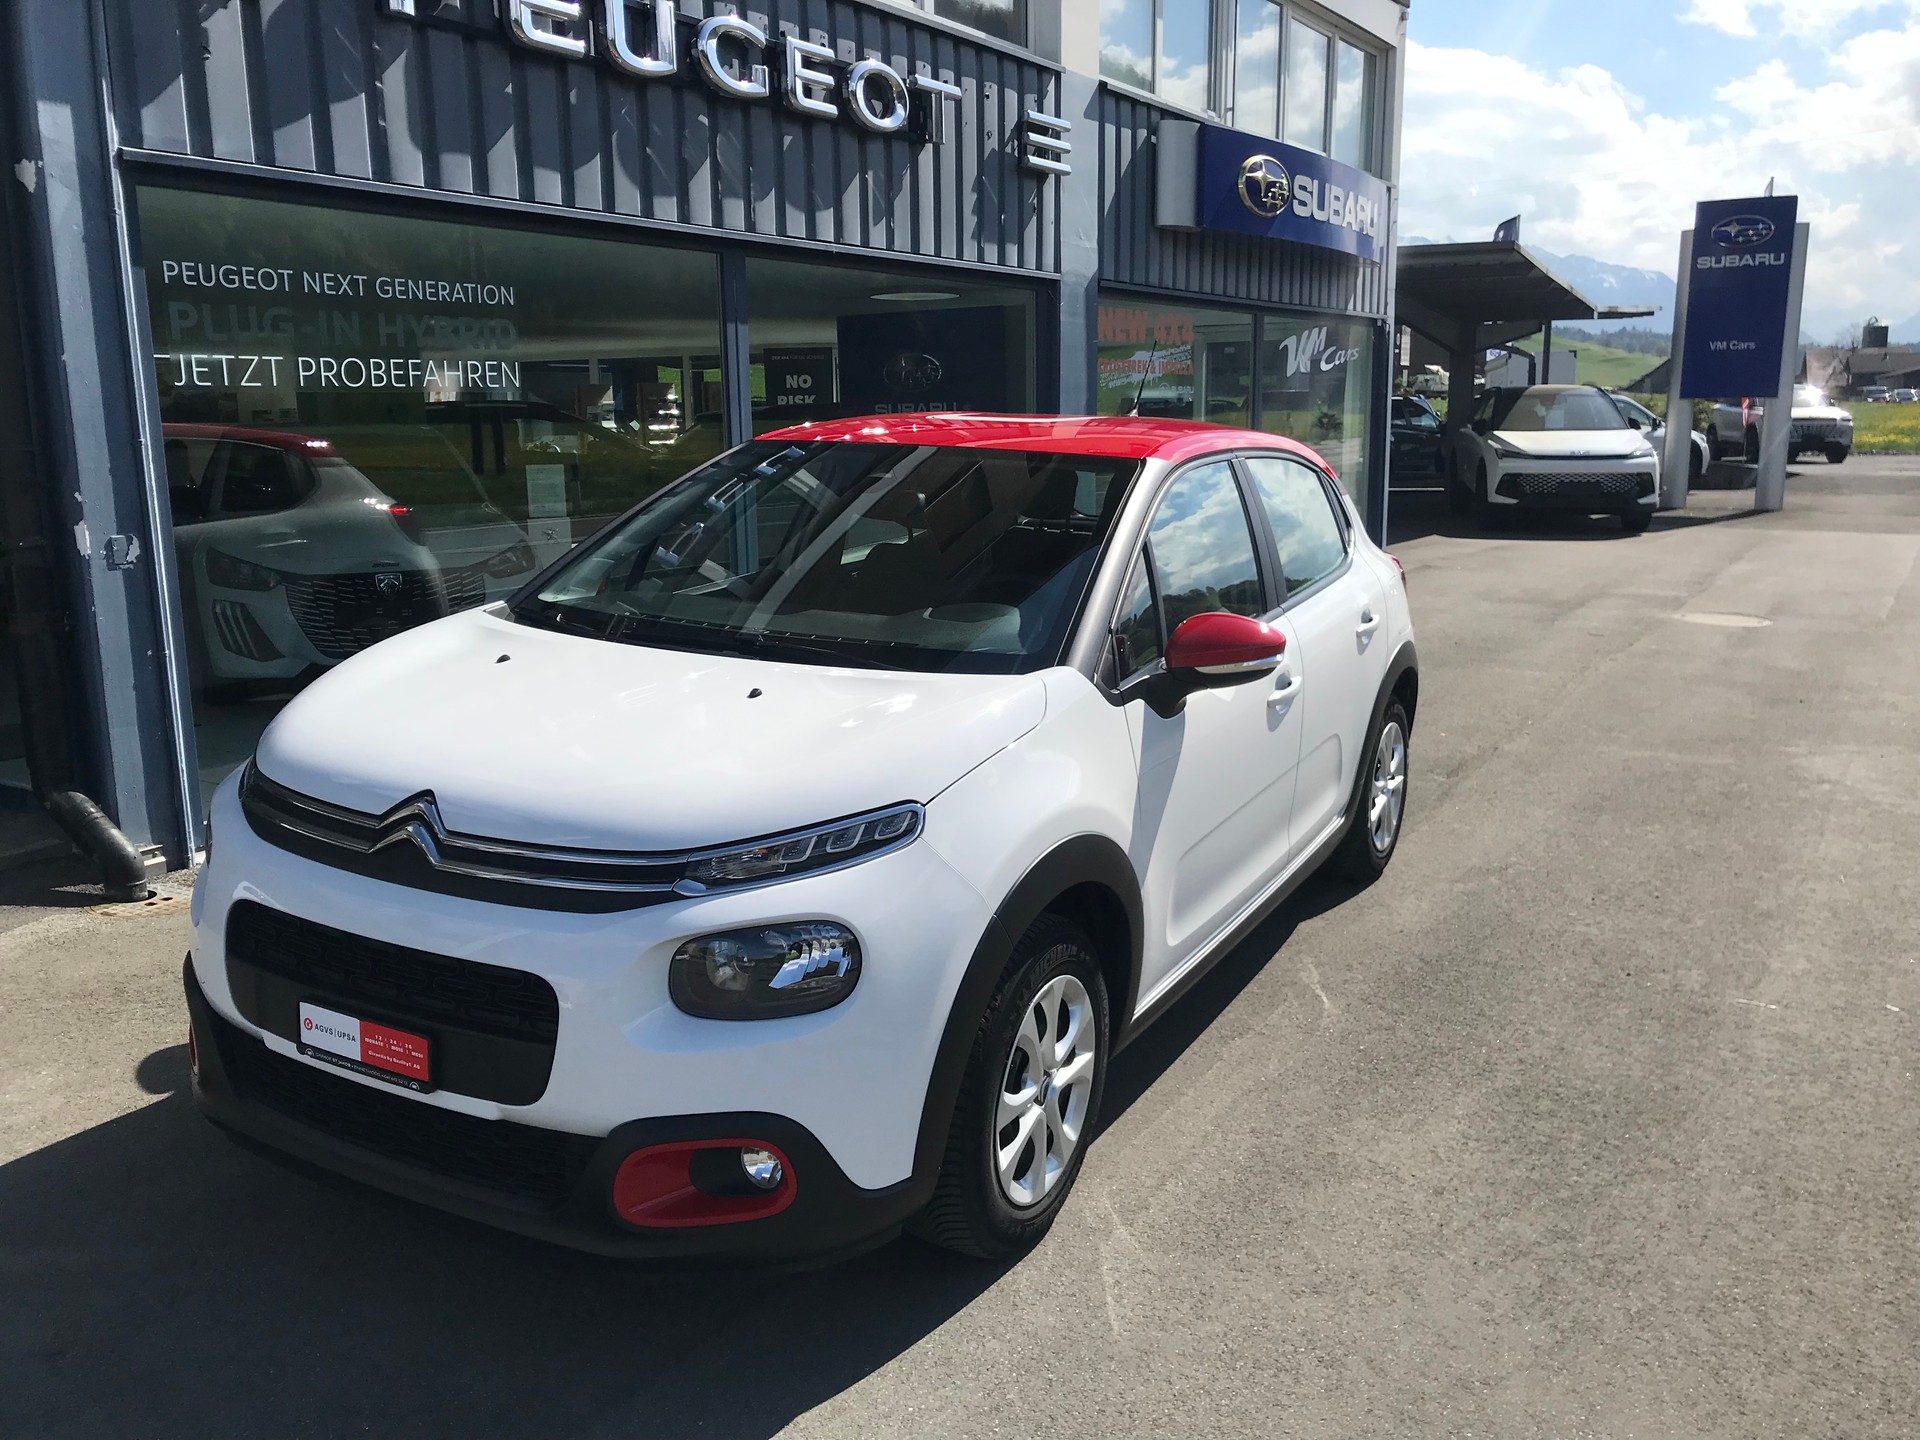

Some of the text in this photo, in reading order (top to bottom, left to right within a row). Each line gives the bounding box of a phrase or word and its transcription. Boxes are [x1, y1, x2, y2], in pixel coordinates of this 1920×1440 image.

[386, 0, 962, 146] EUGEOT
[1293, 174, 1378, 237] SUBARU
[1697, 252, 1785, 269] SUBARU
[162, 260, 515, 306] PEUGEOT NEXT GENERATION
[168, 301, 361, 347] PLUG-IN
[1320, 346, 1360, 371] Cars
[1709, 340, 1756, 351] VM Cars
[174, 354, 520, 388] JETZT PROBEFAHREN
[785, 374, 812, 389] NO
